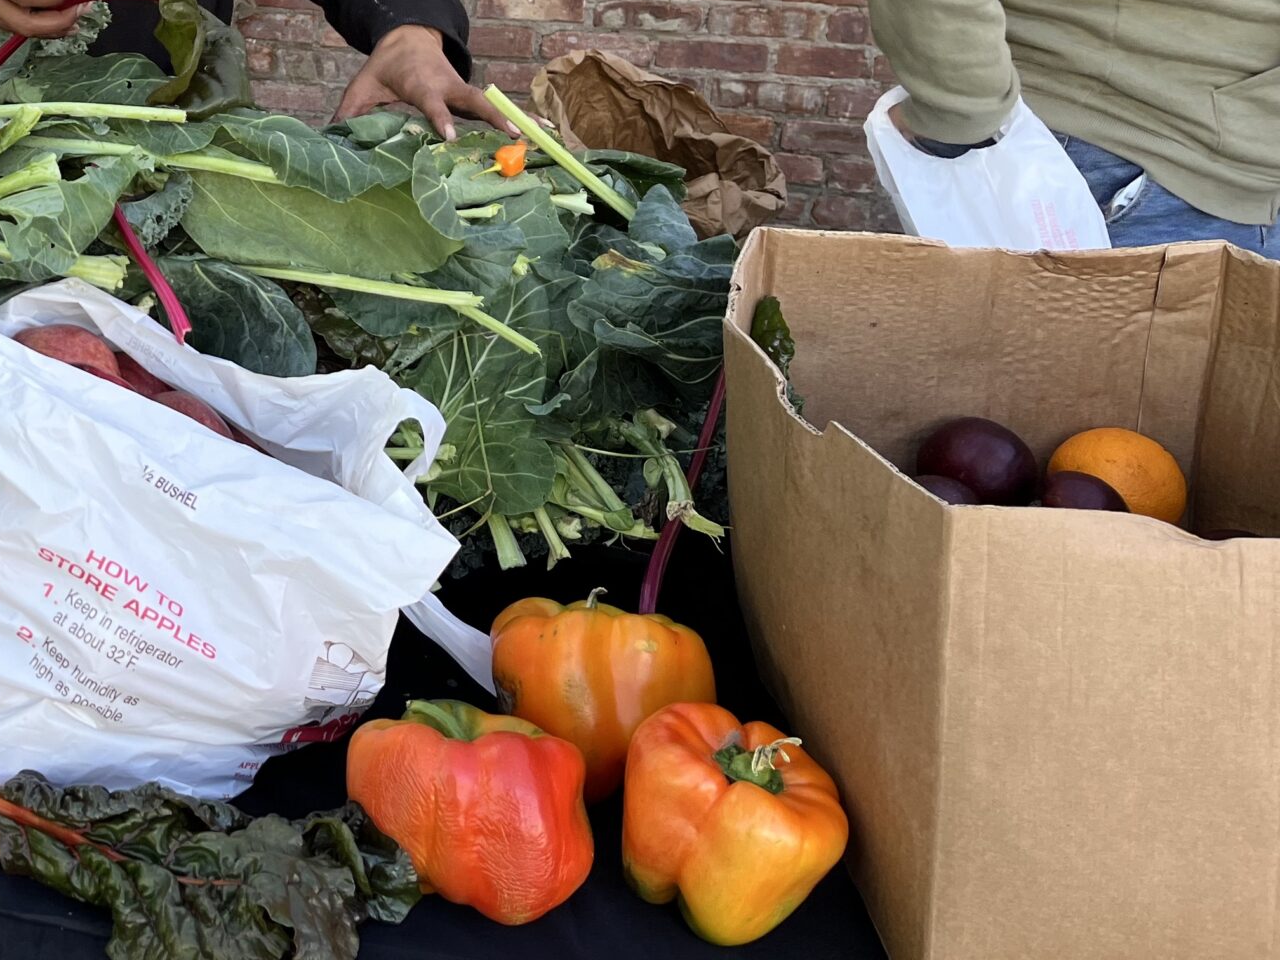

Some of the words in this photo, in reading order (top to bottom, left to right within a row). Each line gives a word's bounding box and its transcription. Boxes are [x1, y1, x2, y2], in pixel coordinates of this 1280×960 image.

[154, 476, 197, 510] BUSHEL
[38, 547, 119, 601] STORE
[123, 599, 216, 659] APPLES
[85, 550, 148, 592] HOW
[156, 590, 184, 617] TO
[43, 583, 58, 605] 1.
[65, 588, 98, 619] Keep
[99, 611, 113, 630] in
[114, 625, 184, 668] refrigerator
[53, 610, 68, 627] at
[69, 621, 105, 652] about
[16, 626, 36, 648] 2.
[42, 636, 70, 669] Keep
[72, 664, 121, 702] humidity
[123, 695, 140, 706] as
[29, 653, 54, 682] high
[55, 680, 70, 697] as
